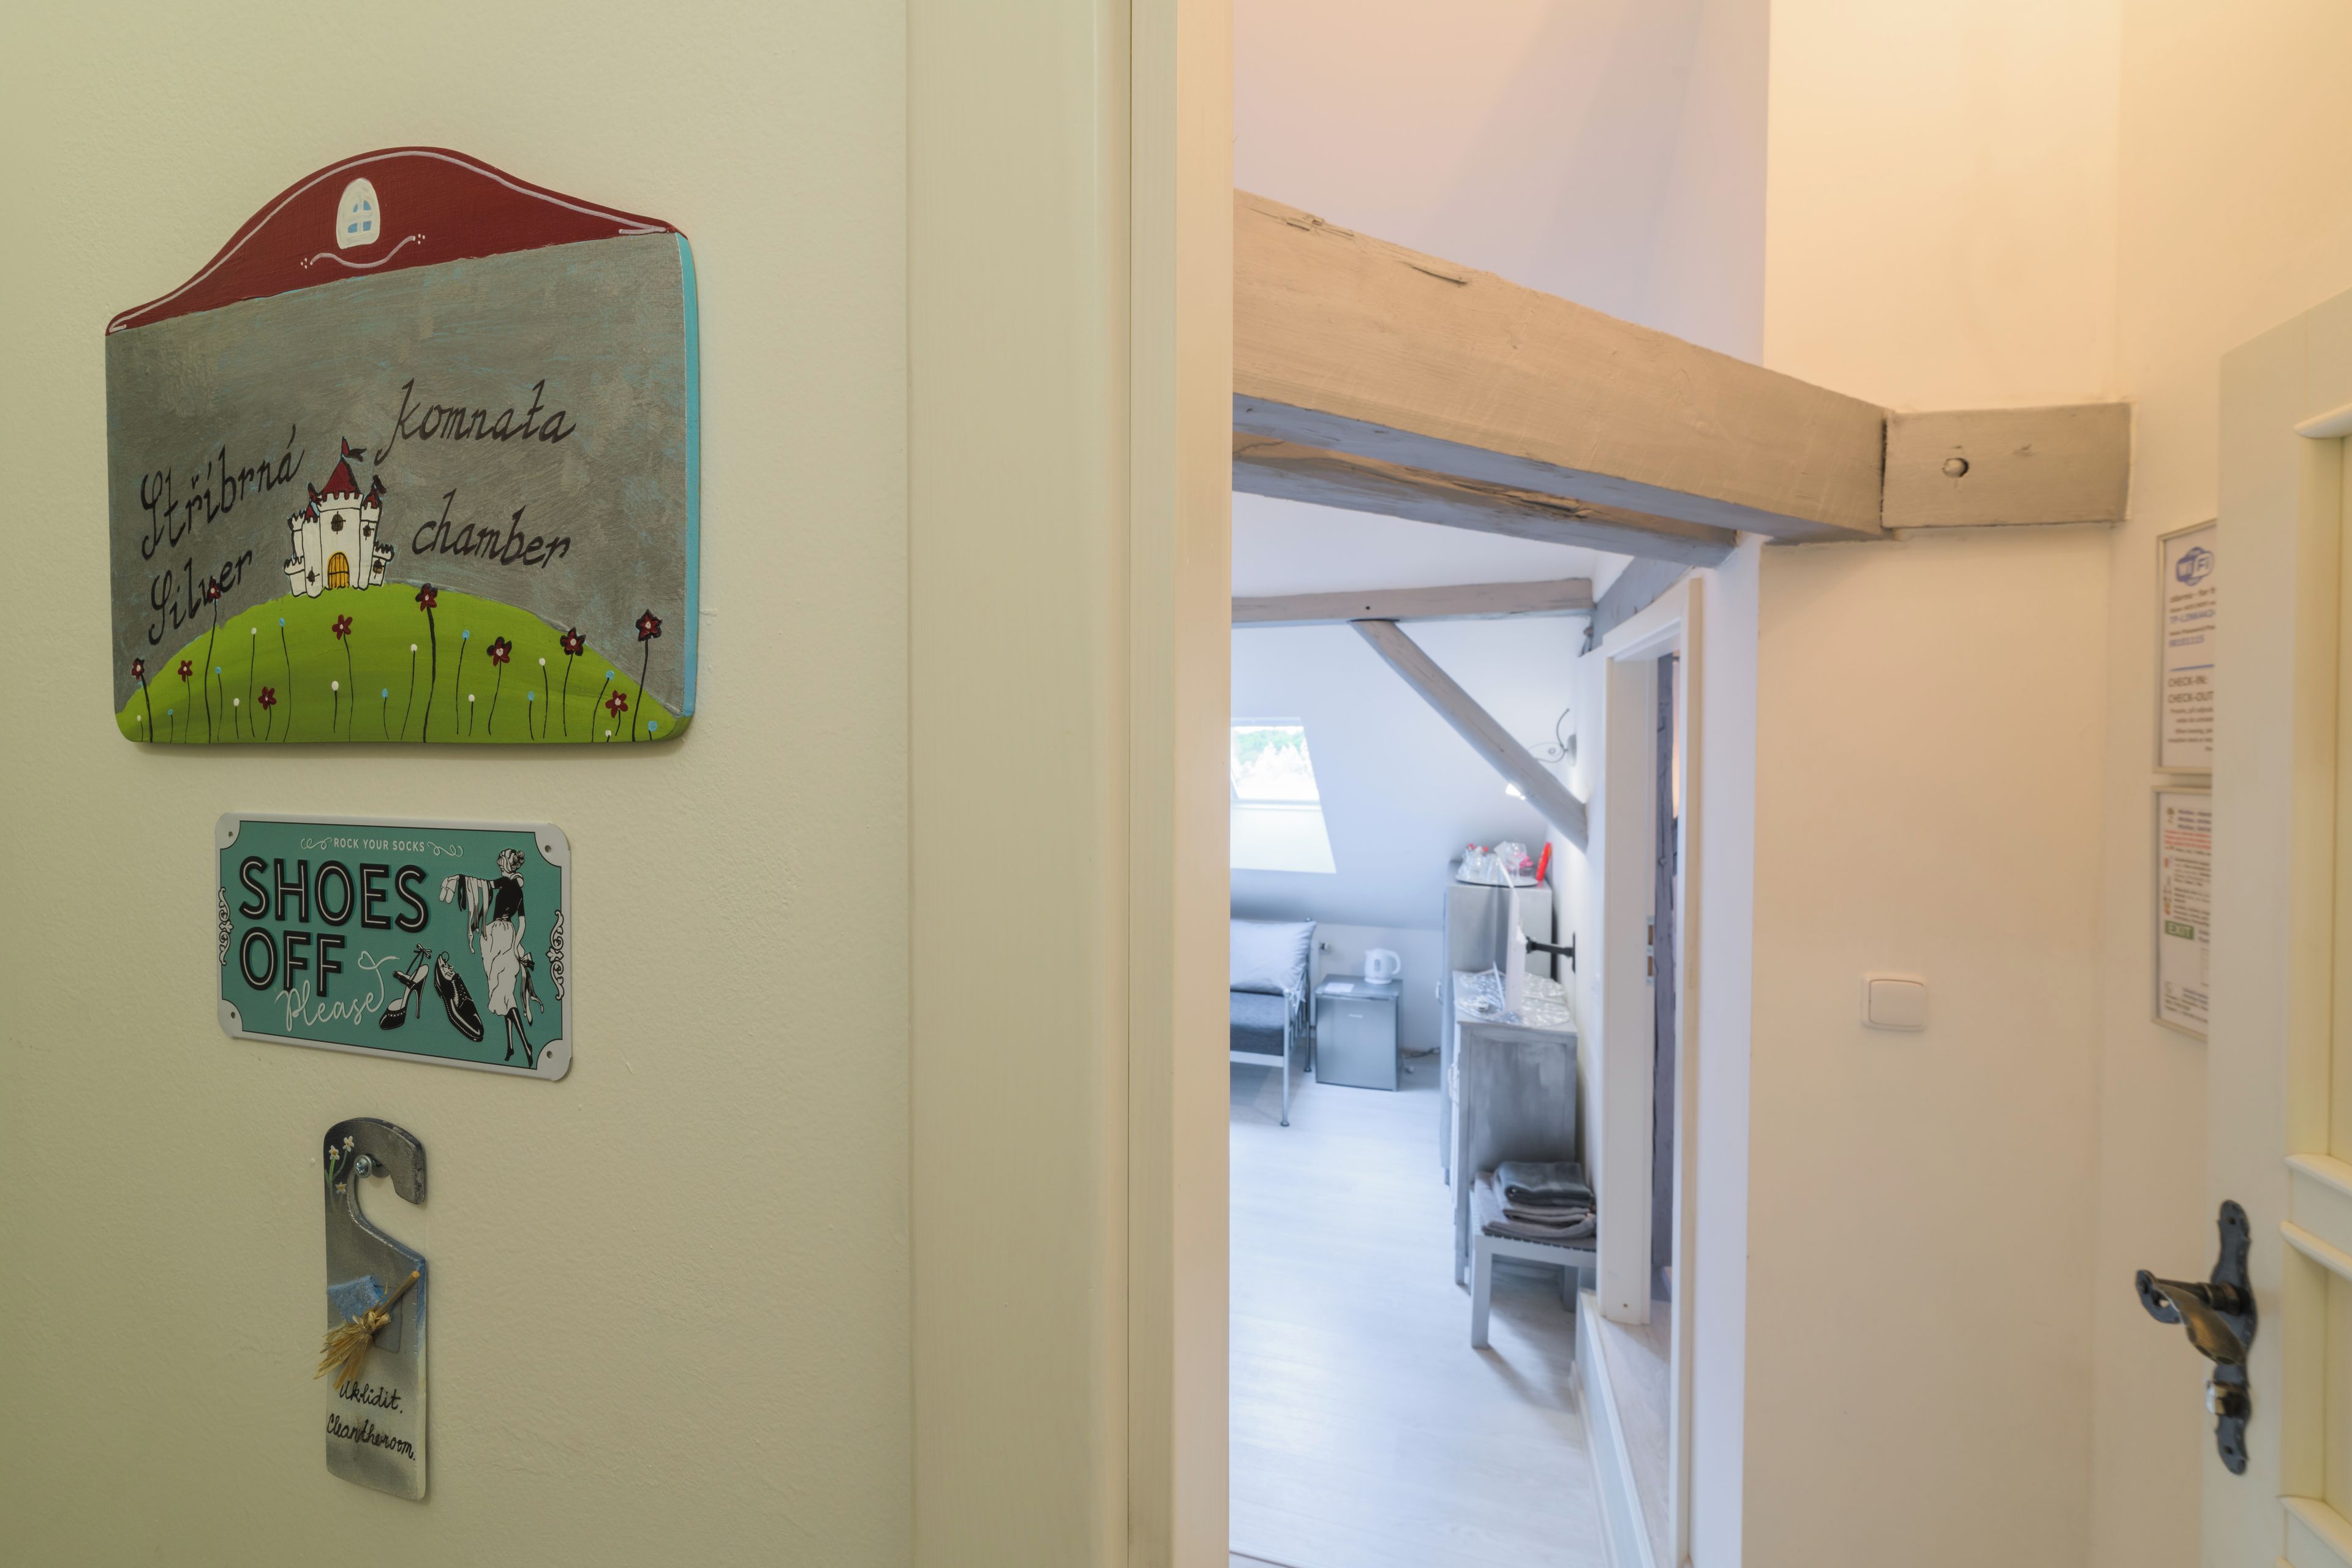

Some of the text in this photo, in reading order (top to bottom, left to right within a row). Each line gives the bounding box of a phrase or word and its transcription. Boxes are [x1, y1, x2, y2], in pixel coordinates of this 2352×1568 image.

[141, 424, 304, 561] Stříbrná
[411, 488, 571, 570] chamber
[334, 837, 425, 852] ROCK YOUR SOCKS
[239, 855, 430, 933] SHOES
[239, 926, 347, 998] OFF
